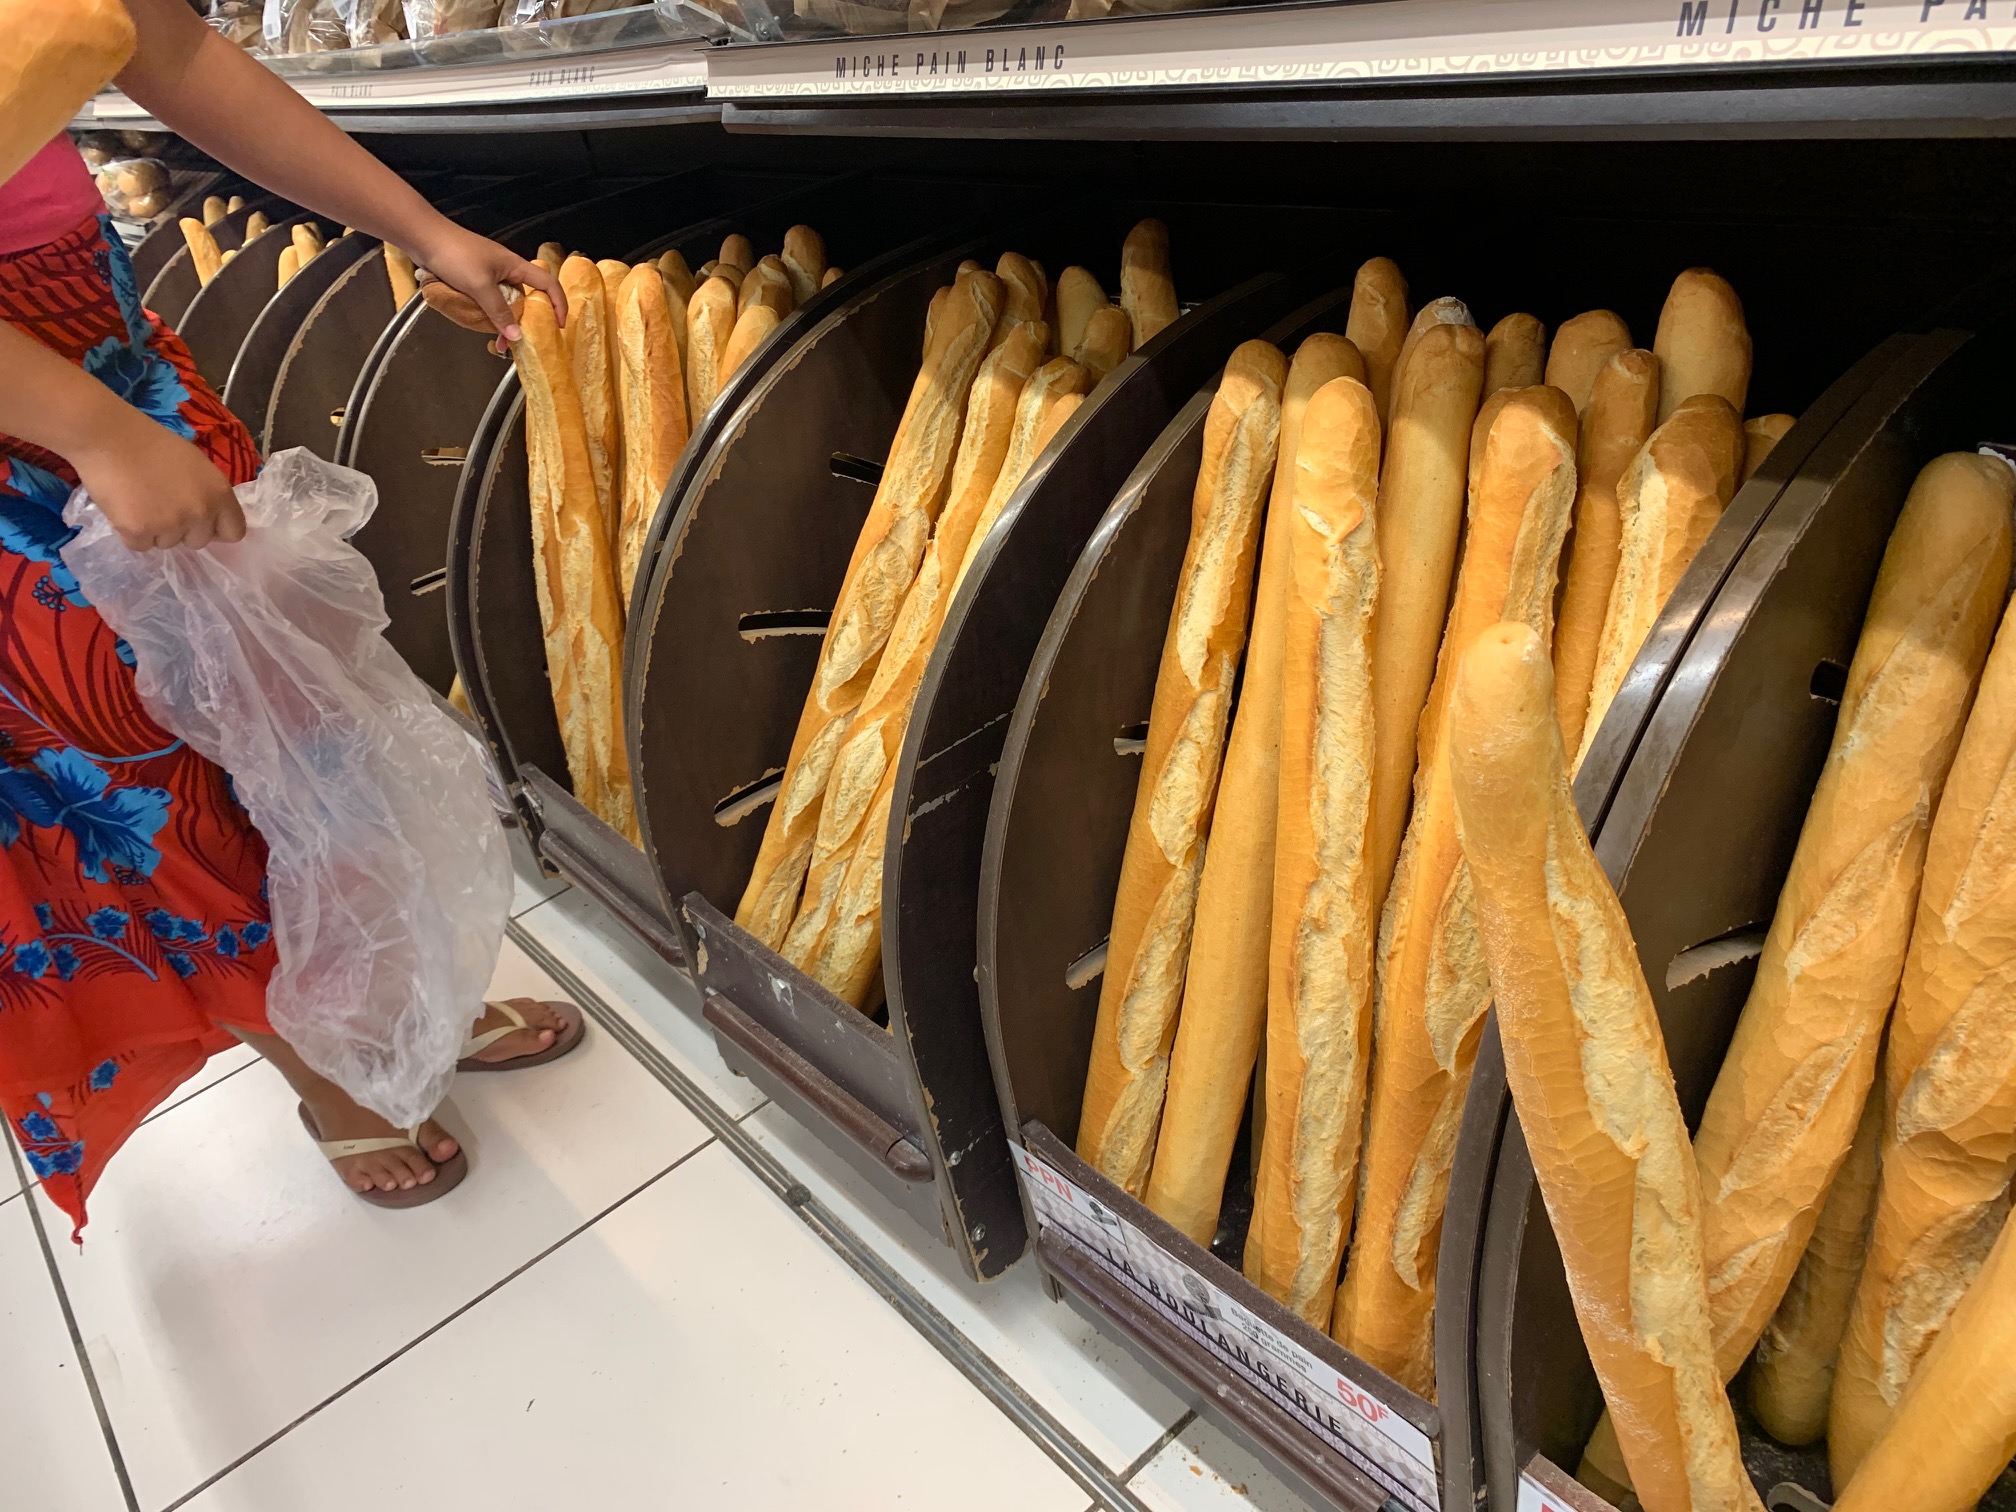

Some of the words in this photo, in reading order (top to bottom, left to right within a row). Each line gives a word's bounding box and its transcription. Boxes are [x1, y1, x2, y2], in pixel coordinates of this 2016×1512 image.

[1676, 0, 1863, 37] MICHE
[529, 70, 554, 87] PAIN
[560, 66, 595, 85] BLANC
[836, 54, 899, 78] MICHE
[916, 51, 966, 75] PAIN
[985, 45, 1064, 73] BLANC
[1024, 1154, 1073, 1203] PPN
[1107, 1247, 1136, 1280] LA
[1148, 1278, 1343, 1437] BOULANGERIE
[1231, 1307, 1274, 1343] Baguette
[1276, 1340, 1290, 1353] de
[1291, 1350, 1314, 1370] pain
[1261, 1338, 1307, 1374] grammes
